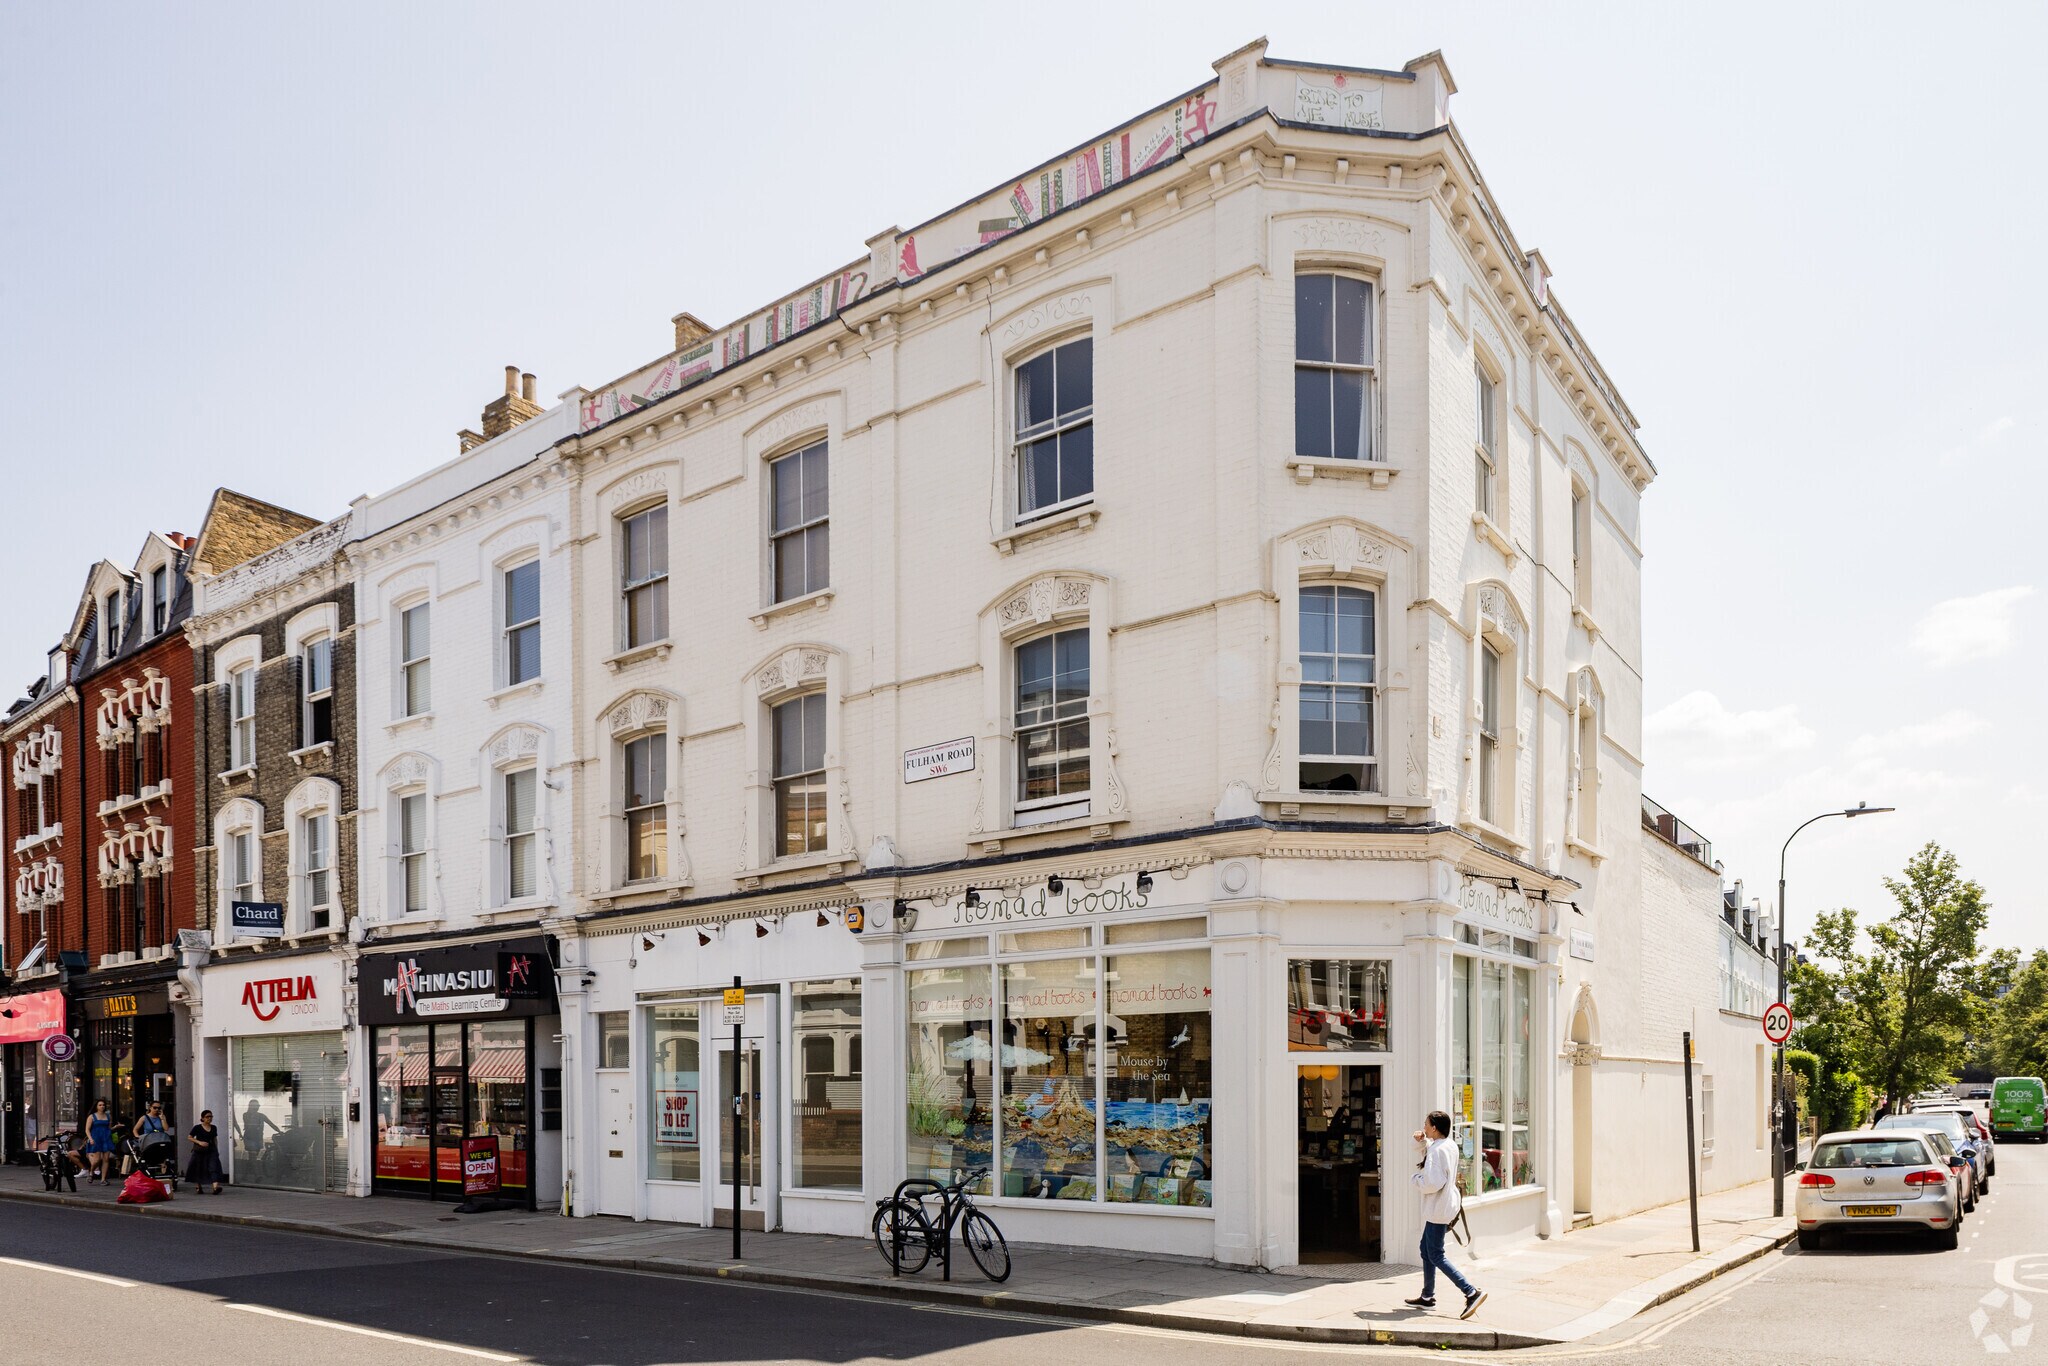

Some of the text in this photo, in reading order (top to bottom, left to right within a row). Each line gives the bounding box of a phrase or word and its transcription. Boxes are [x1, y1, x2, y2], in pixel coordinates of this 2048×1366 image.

[1344, 93, 1364, 109] TO
[1344, 111, 1380, 128] MUSE
[906, 746, 972, 769] FULHAM ROAD
[930, 764, 948, 775] SW6
[954, 882, 1149, 923] nomad books
[1458, 885, 1534, 929] nomad books
[236, 906, 279, 920] Chard
[241, 975, 317, 1021] ATTELIA
[1008, 988, 1086, 1008] nomad books
[1111, 982, 1198, 1003] nomad books
[109, 995, 137, 1012] MATT'S
[291, 1003, 319, 1016] LONDON
[419, 997, 502, 1012] The Maths Learning Centre
[911, 994, 984, 1012] nomad books
[1768, 1015, 1788, 1030] 20
[1120, 1056, 1169, 1070] Mouse by
[1133, 1070, 1171, 1080] the Sea
[2004, 1090, 2033, 1098] 100%
[666, 1097, 688, 1110] SHOP
[663, 1113, 690, 1127] TO LET
[469, 1151, 492, 1159] WE'RE
[467, 1162, 494, 1173] OPEN
[1852, 1206, 1891, 1215] VN12 KDK
